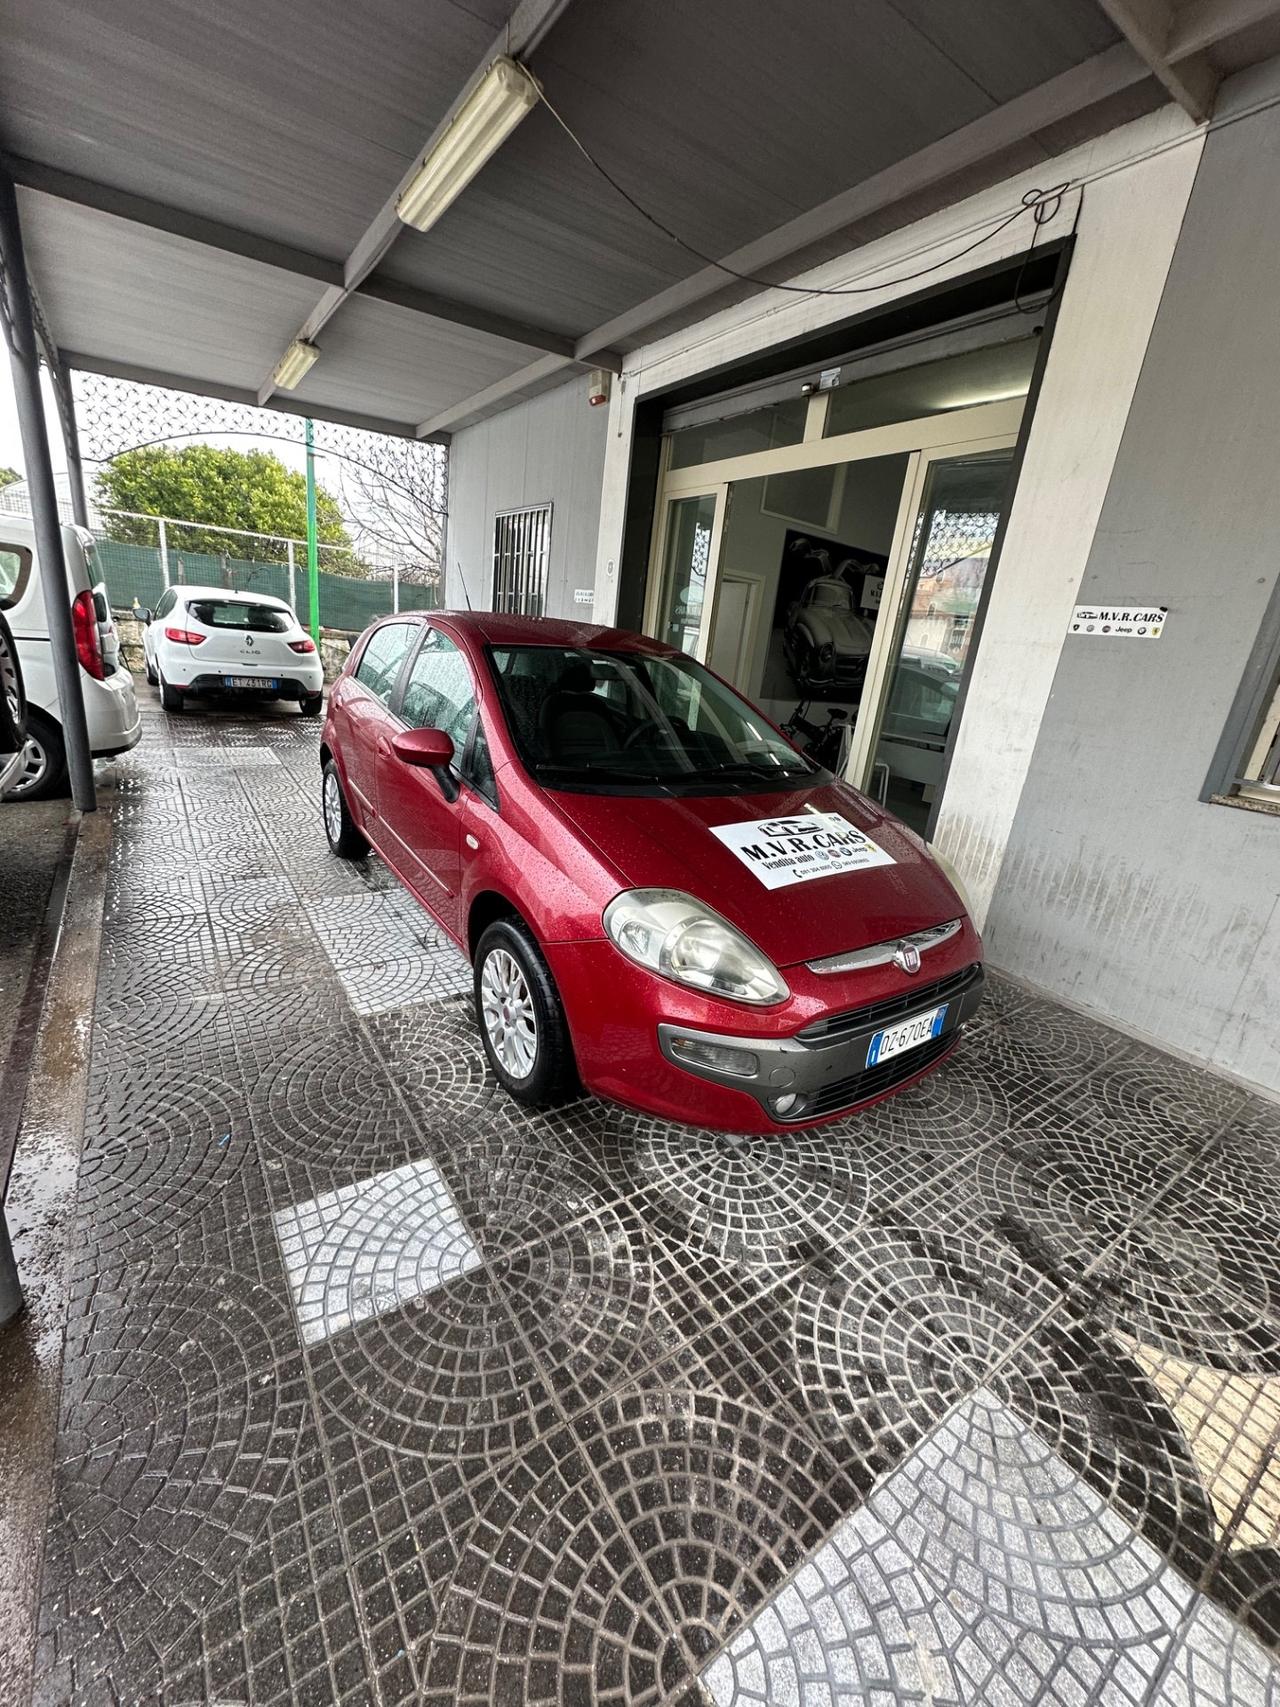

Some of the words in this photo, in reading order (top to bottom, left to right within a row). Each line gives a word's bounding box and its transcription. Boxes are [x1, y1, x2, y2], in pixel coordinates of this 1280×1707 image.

[1099, 611, 1164, 622] M.V.R.CARS
[740, 830, 866, 862] M.V.R.CARS
[762, 857, 796, 870] Vendita
[795, 854, 815, 864] auto
